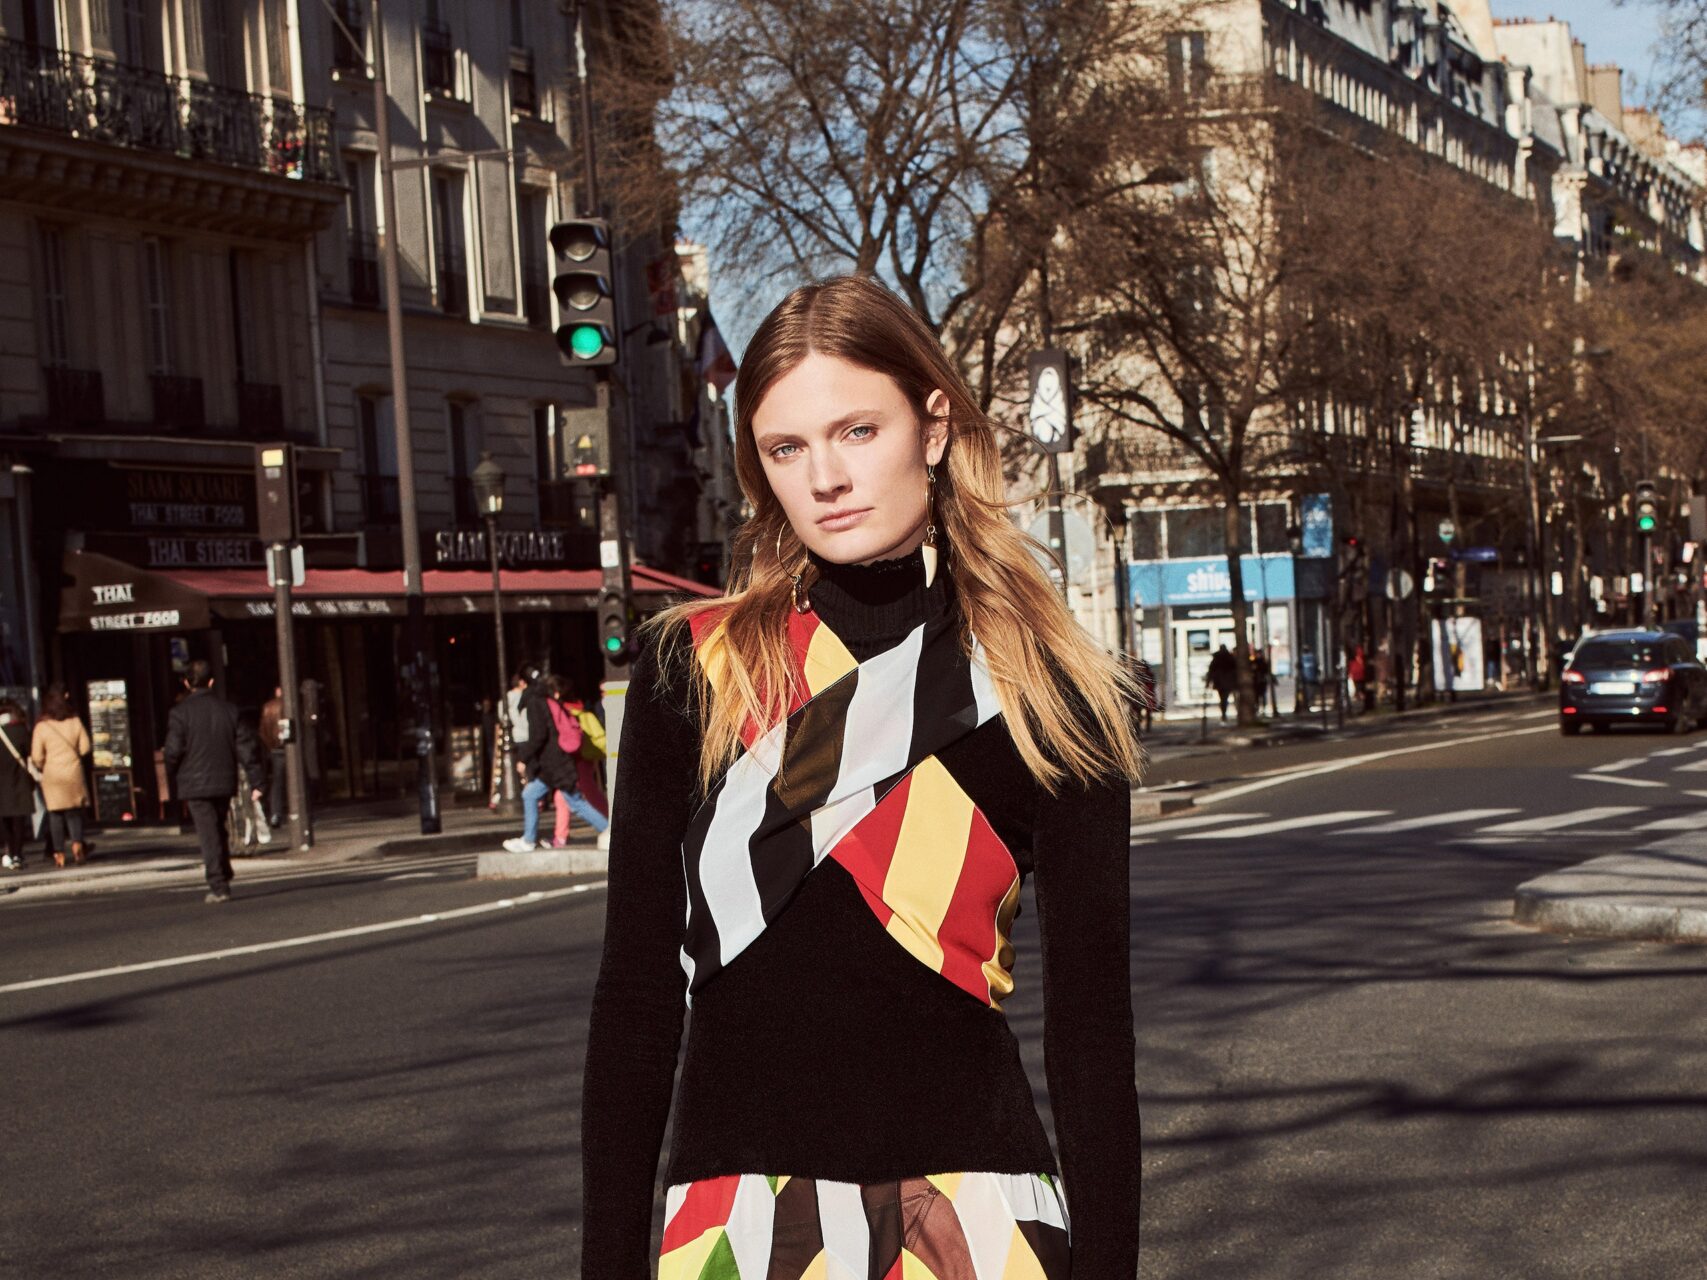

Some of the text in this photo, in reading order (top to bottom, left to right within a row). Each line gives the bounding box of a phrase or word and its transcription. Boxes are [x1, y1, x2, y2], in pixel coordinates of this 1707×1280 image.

[128, 474, 245, 502] SIAM SQUARE
[130, 504, 158, 525] THAI
[165, 504, 206, 525] STREET
[149, 538, 251, 566] THAI STREET
[435, 531, 486, 562] SIAM
[91, 583, 135, 605] THAI
[90, 610, 179, 630] STREET FOOD
